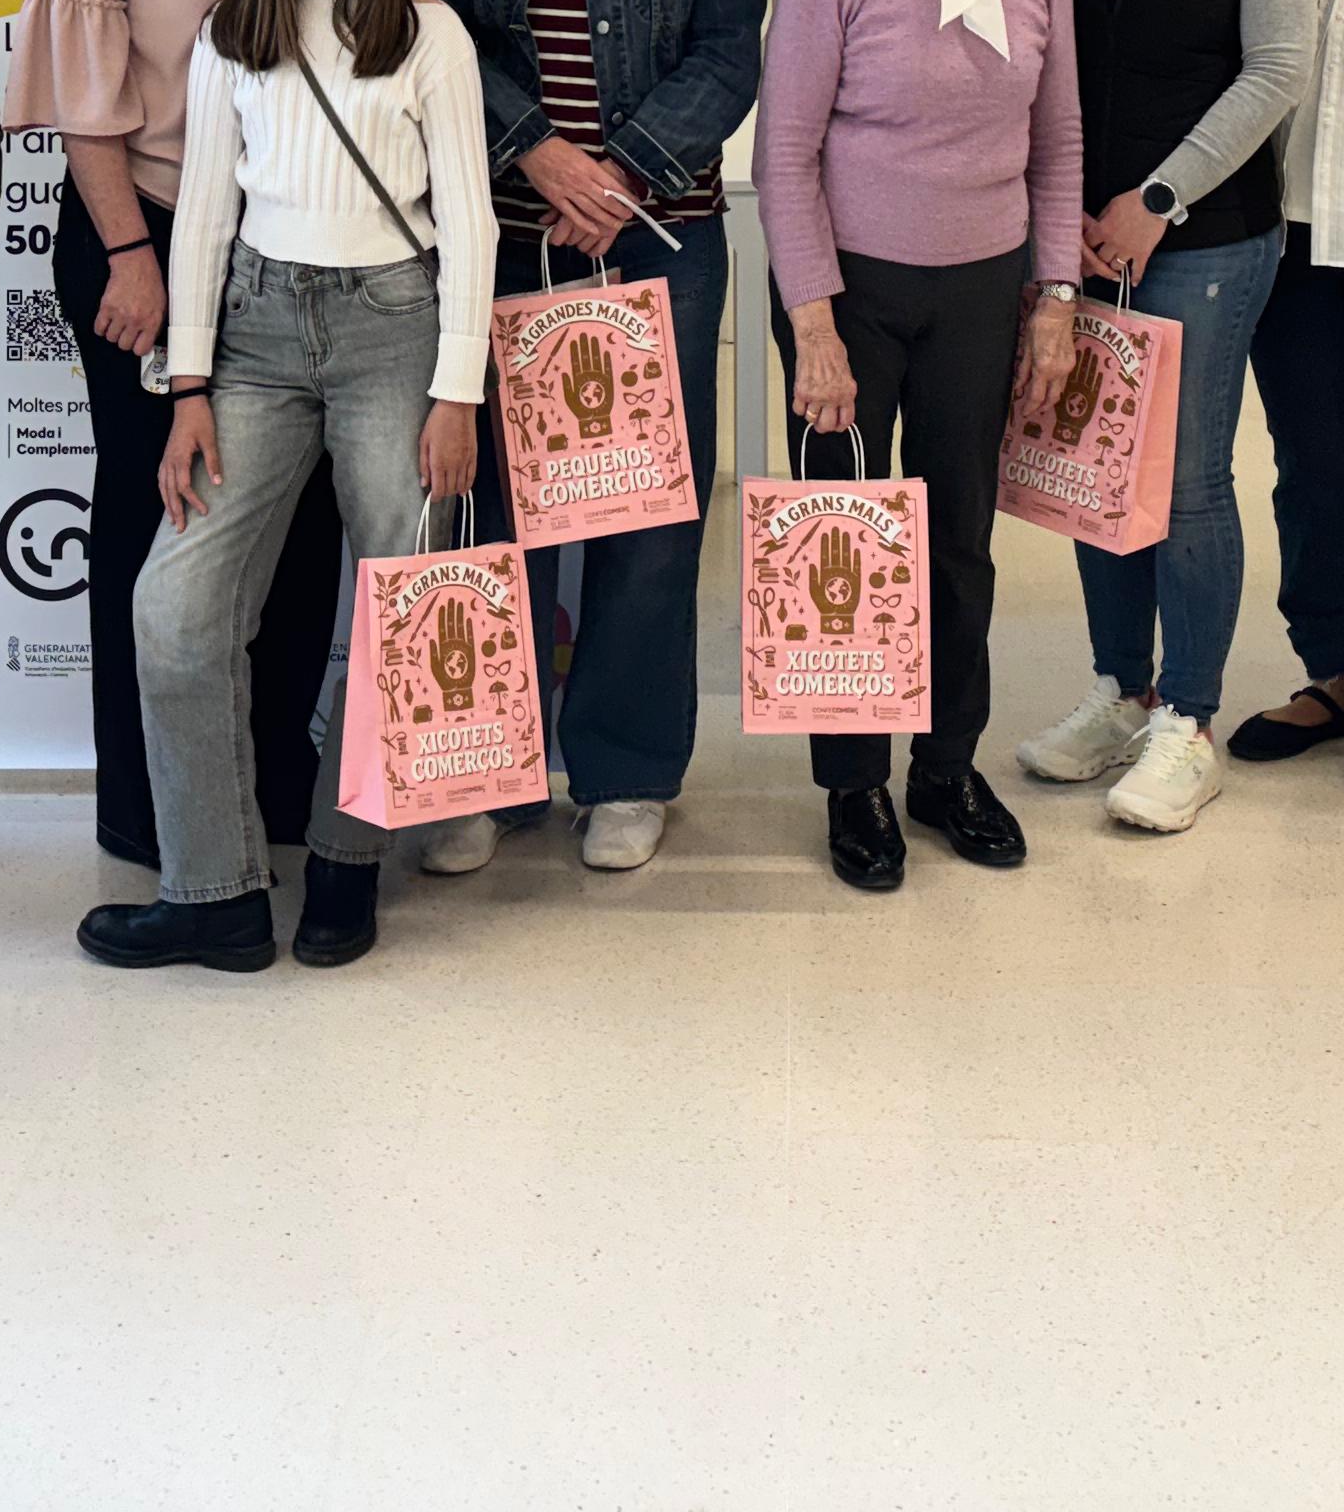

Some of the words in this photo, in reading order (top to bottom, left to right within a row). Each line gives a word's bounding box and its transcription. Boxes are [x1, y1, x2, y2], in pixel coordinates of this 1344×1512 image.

[5, 225, 56, 255] 50
[528, 302, 593, 339] GRANDES
[597, 303, 645, 336] MALES
[1072, 316, 1102, 334] ANS
[1102, 330, 1134, 365] MALS
[8, 397, 63, 413] Moltes
[17, 427, 55, 439] Moda
[57, 427, 62, 439] i
[545, 444, 654, 482] PEQUEÑOS
[1016, 444, 1098, 488] XICOTETS
[539, 466, 666, 508] COMERCIOS
[1006, 461, 1102, 512] COMERÇOS
[776, 517, 787, 531] A
[787, 496, 846, 521] GRANS
[848, 498, 894, 533] MALS
[402, 594, 413, 609] A
[412, 565, 460, 597] GRANS
[462, 568, 501, 598] MALS
[24, 643, 91, 653] GENERALITAT
[25, 654, 90, 663] VALENCIANA
[786, 649, 885, 672] XICOTETS
[775, 672, 896, 700] COMERÇOS
[416, 722, 505, 756] XICOTETS
[411, 744, 514, 783] COMERÇOS
